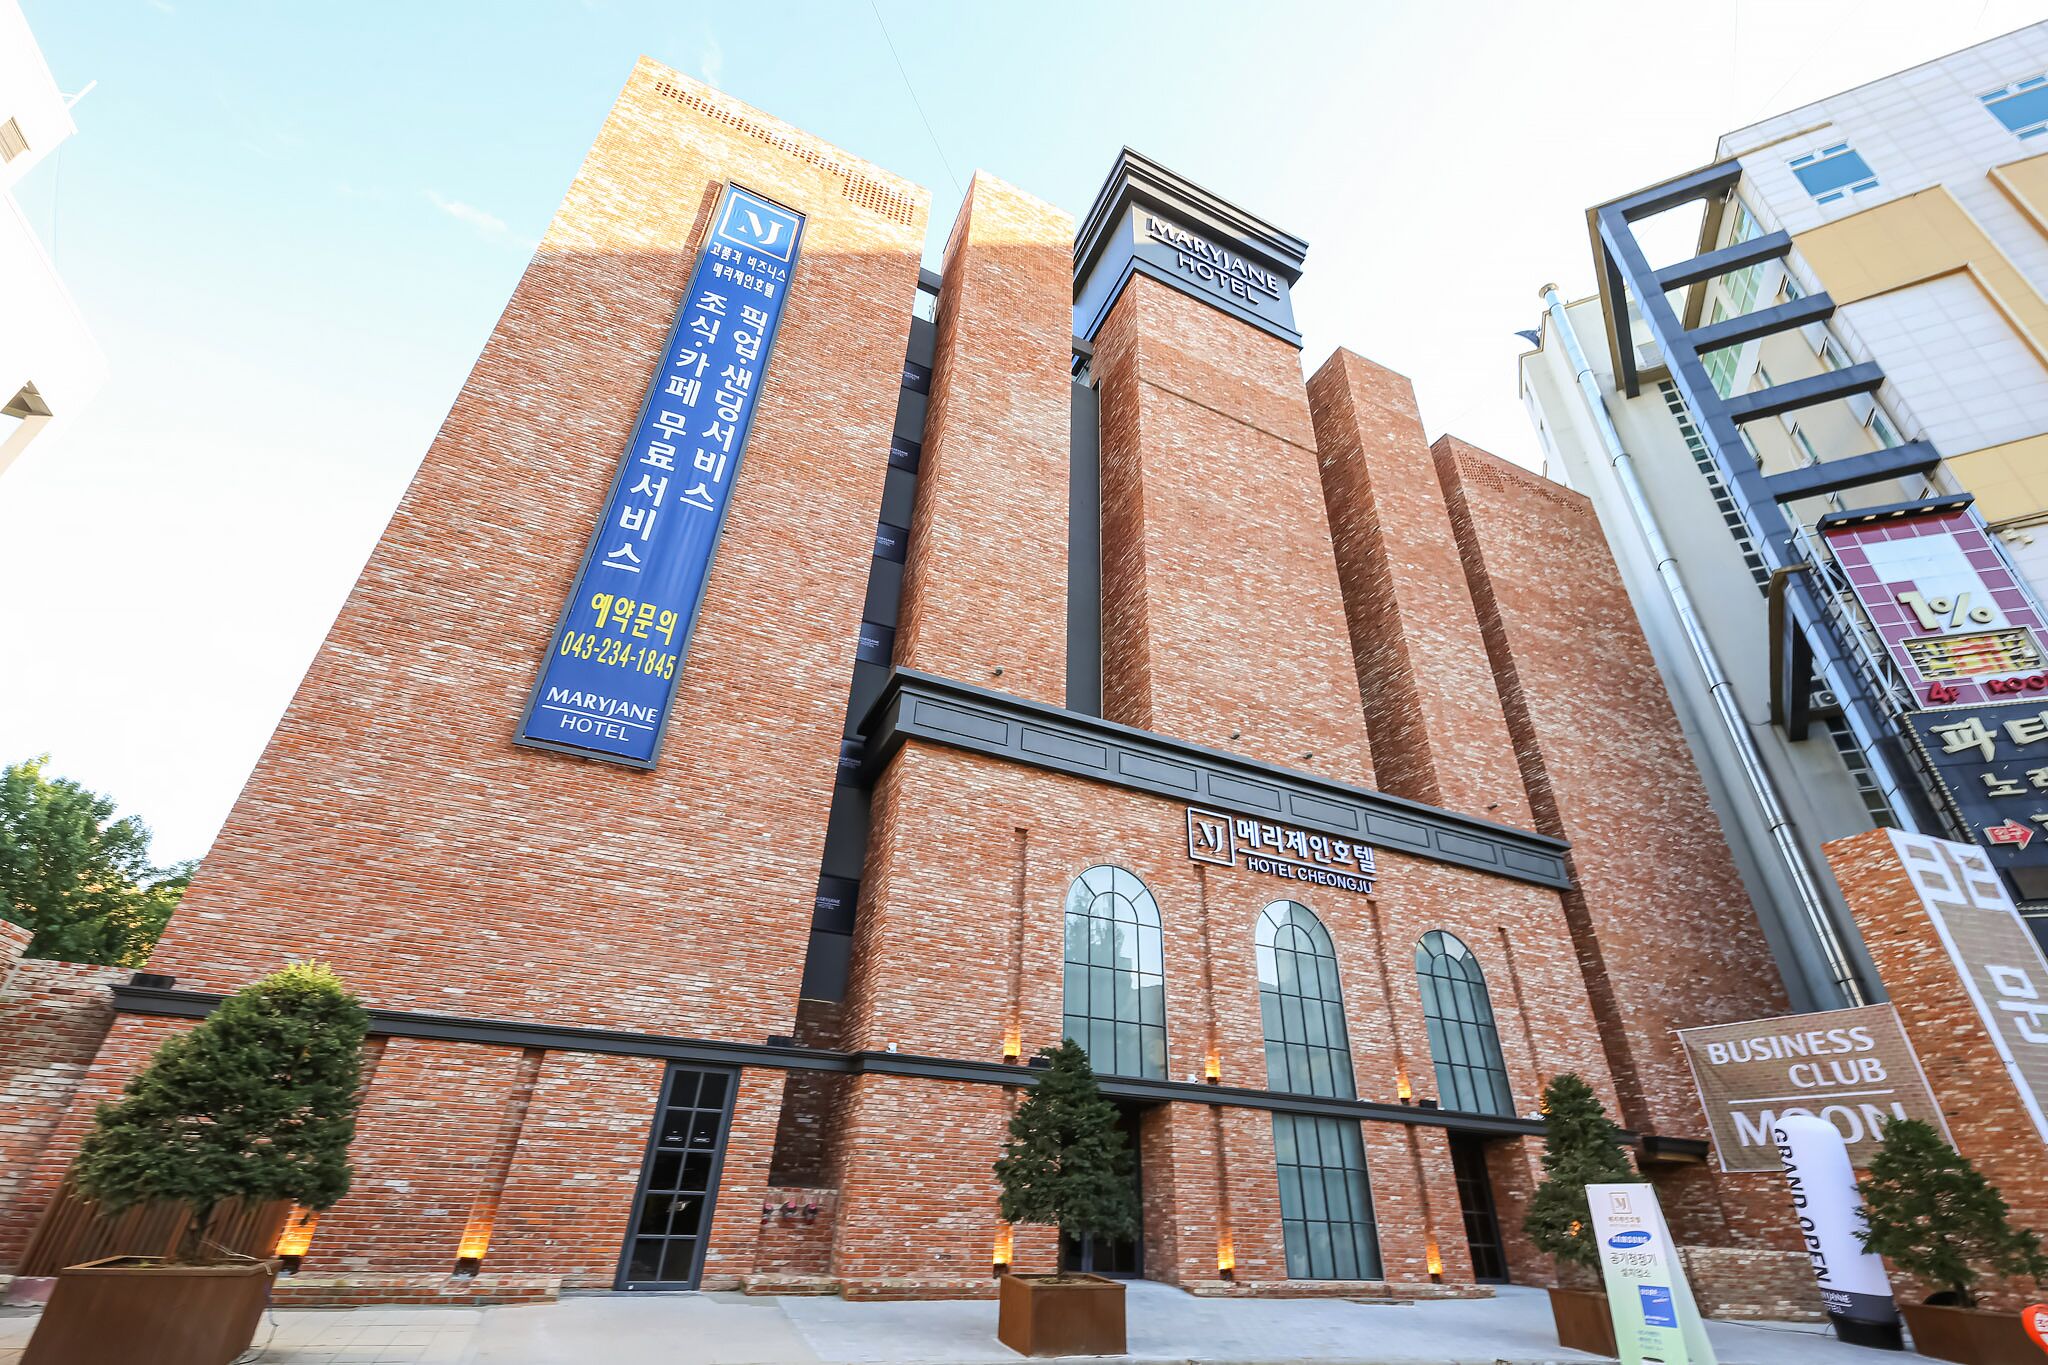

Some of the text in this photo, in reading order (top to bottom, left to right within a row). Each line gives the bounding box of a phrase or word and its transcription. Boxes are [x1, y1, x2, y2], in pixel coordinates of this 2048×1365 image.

[746, 255, 786, 283] 비즈니스
[1149, 215, 1279, 293] MARYJANE
[712, 262, 776, 299] 메리제인호텔
[1177, 250, 1260, 304] HOTEL
[601, 410, 687, 573] 무료서비스
[590, 592, 679, 646] 예약문의
[1895, 591, 1994, 631] 1%
[560, 630, 677, 681] 043-234-1845
[1986, 674, 2048, 694] ROO
[545, 685, 659, 724] MARYJANE
[559, 714, 630, 742] HOTEL
[1236, 818, 1378, 874] 메리제인호텔
[1247, 856, 1374, 895] HOTEL CHEONGJU
[1706, 1026, 1875, 1065] BUSINESS
[1788, 1057, 1888, 1089] CLUB
[1729, 1101, 1909, 1147] MON
[1773, 1127, 1832, 1283] GRAND OPEN
